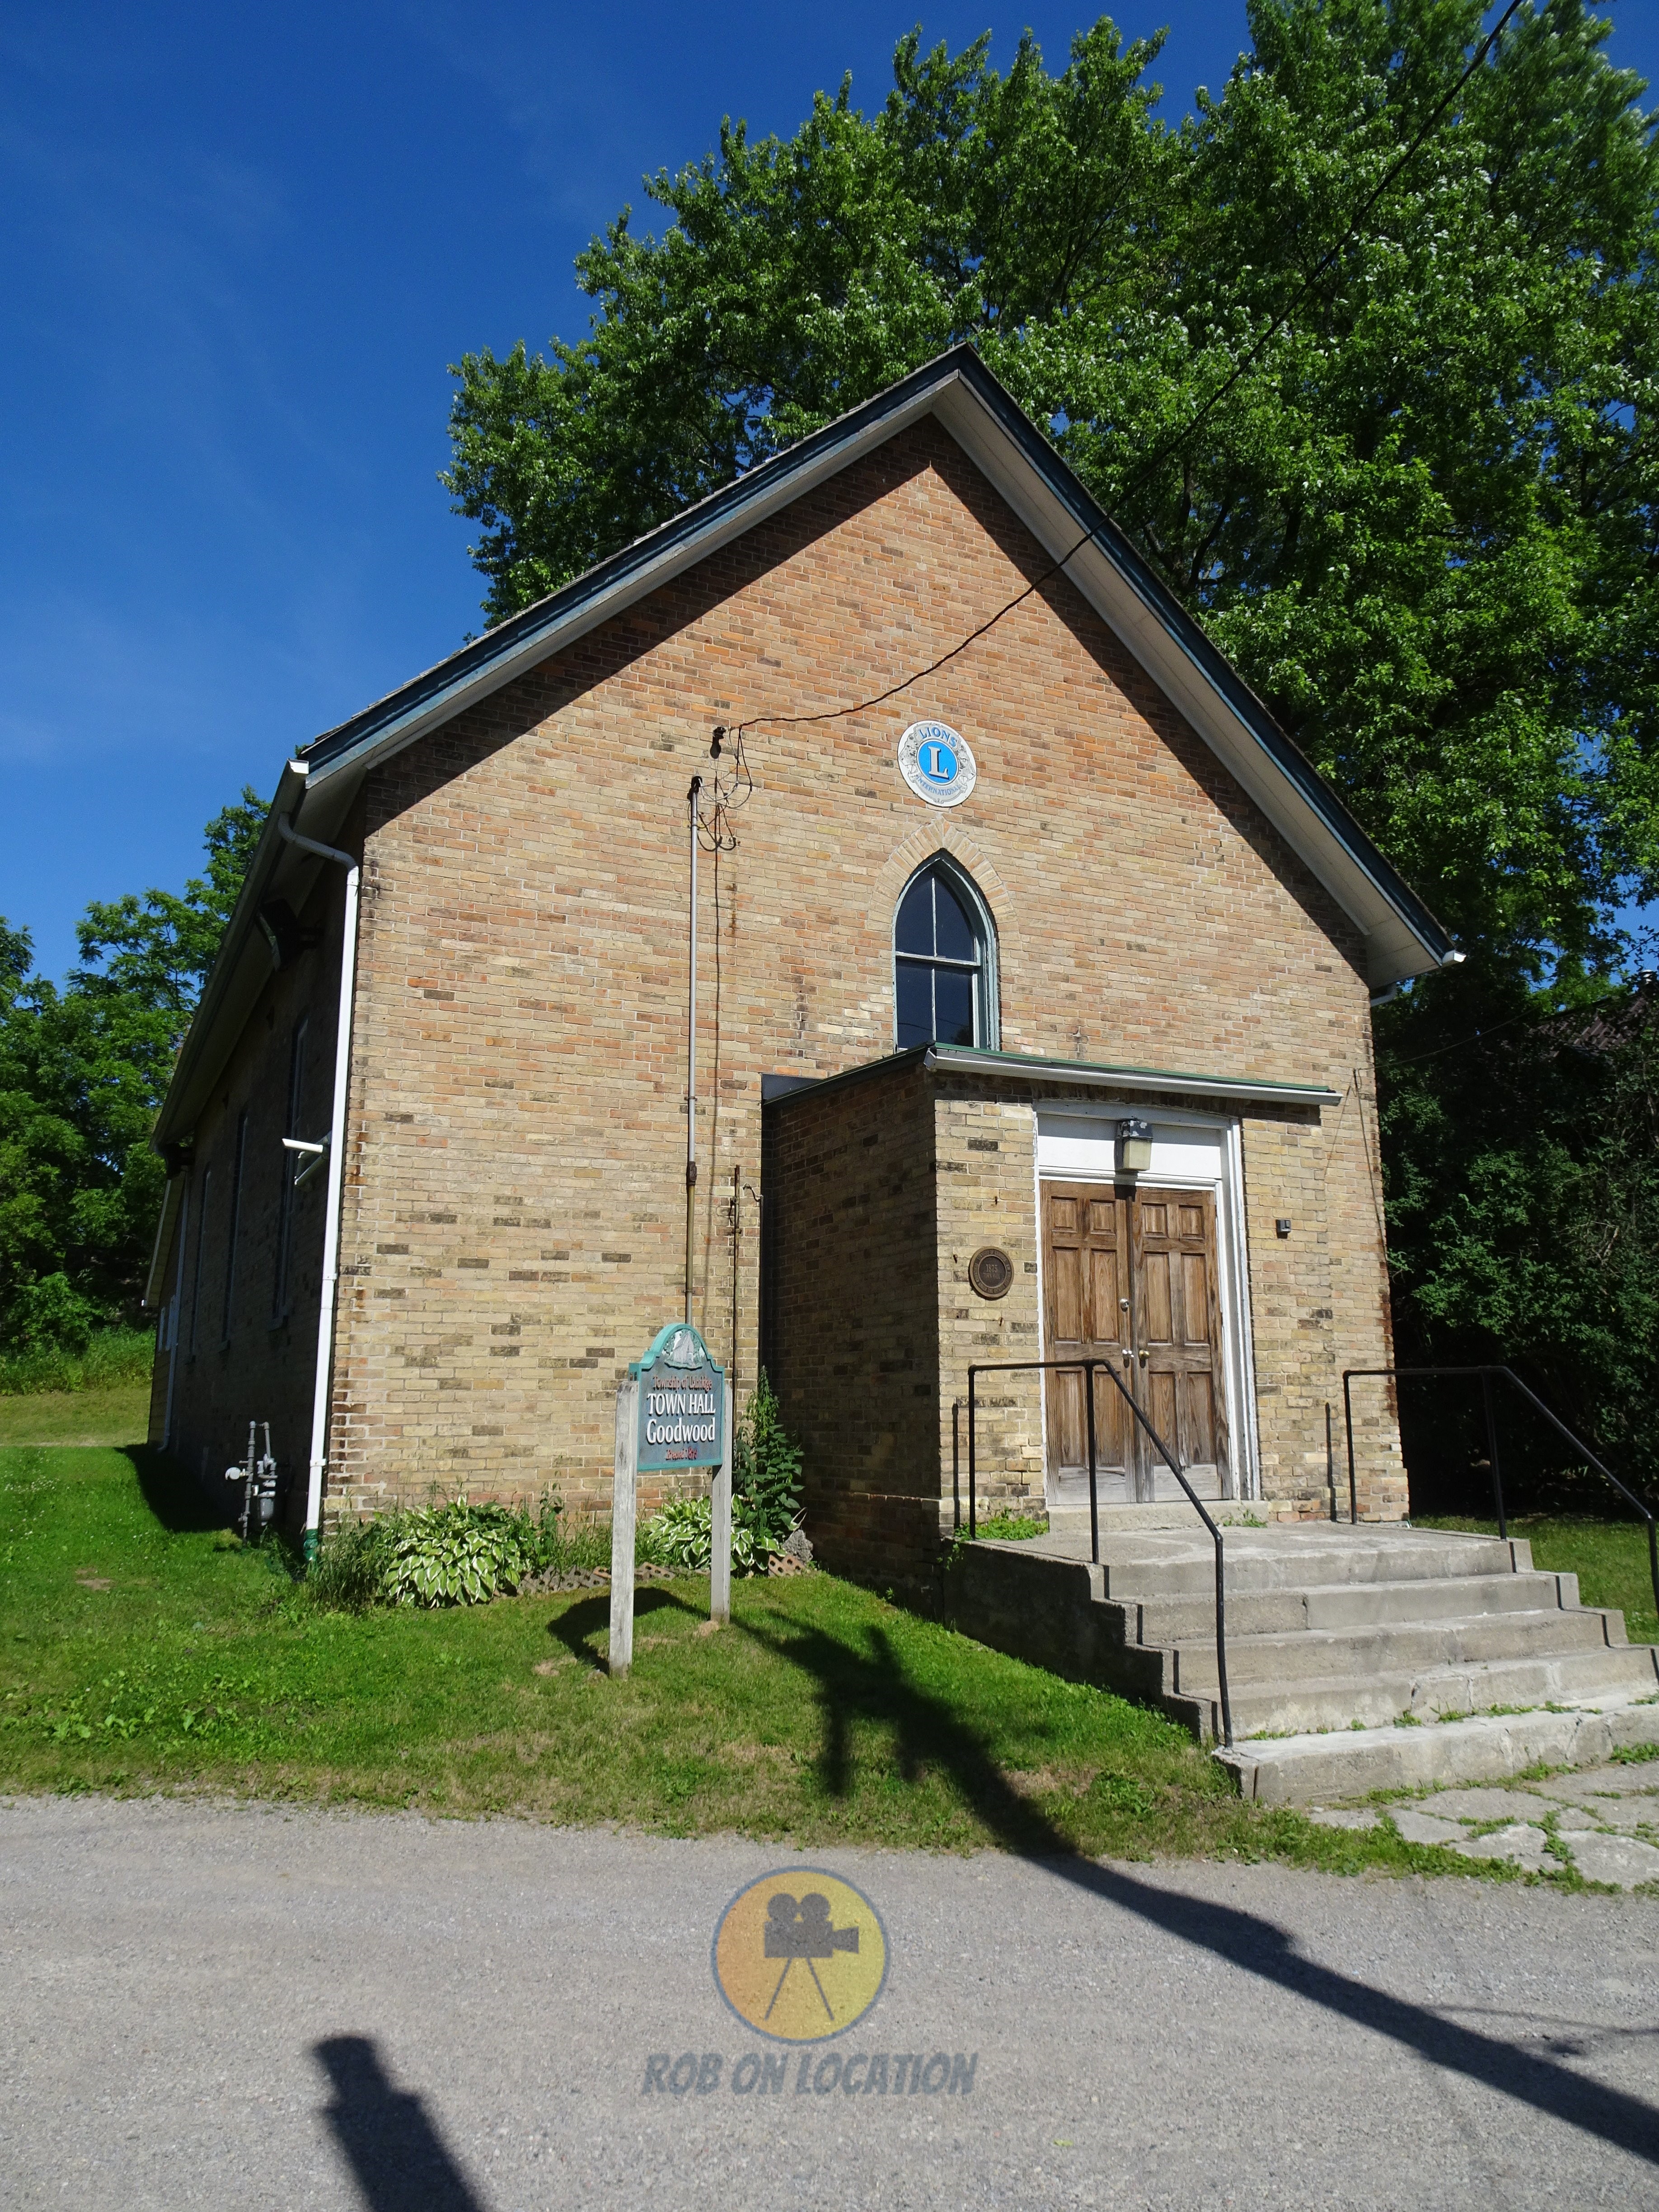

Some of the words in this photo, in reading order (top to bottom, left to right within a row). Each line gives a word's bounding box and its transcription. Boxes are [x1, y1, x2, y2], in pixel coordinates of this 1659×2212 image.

[918, 726, 958, 747] LIONS
[928, 746, 949, 779] L
[916, 775, 962, 796] INTERNATIONAL
[986, 1264, 998, 1273] 1875
[653, 1375, 680, 1390] Township
[681, 1376, 688, 1388] of
[647, 1393, 686, 1415] TOWN
[688, 1393, 716, 1415] HALL
[647, 1417, 716, 1443] Goodwood
